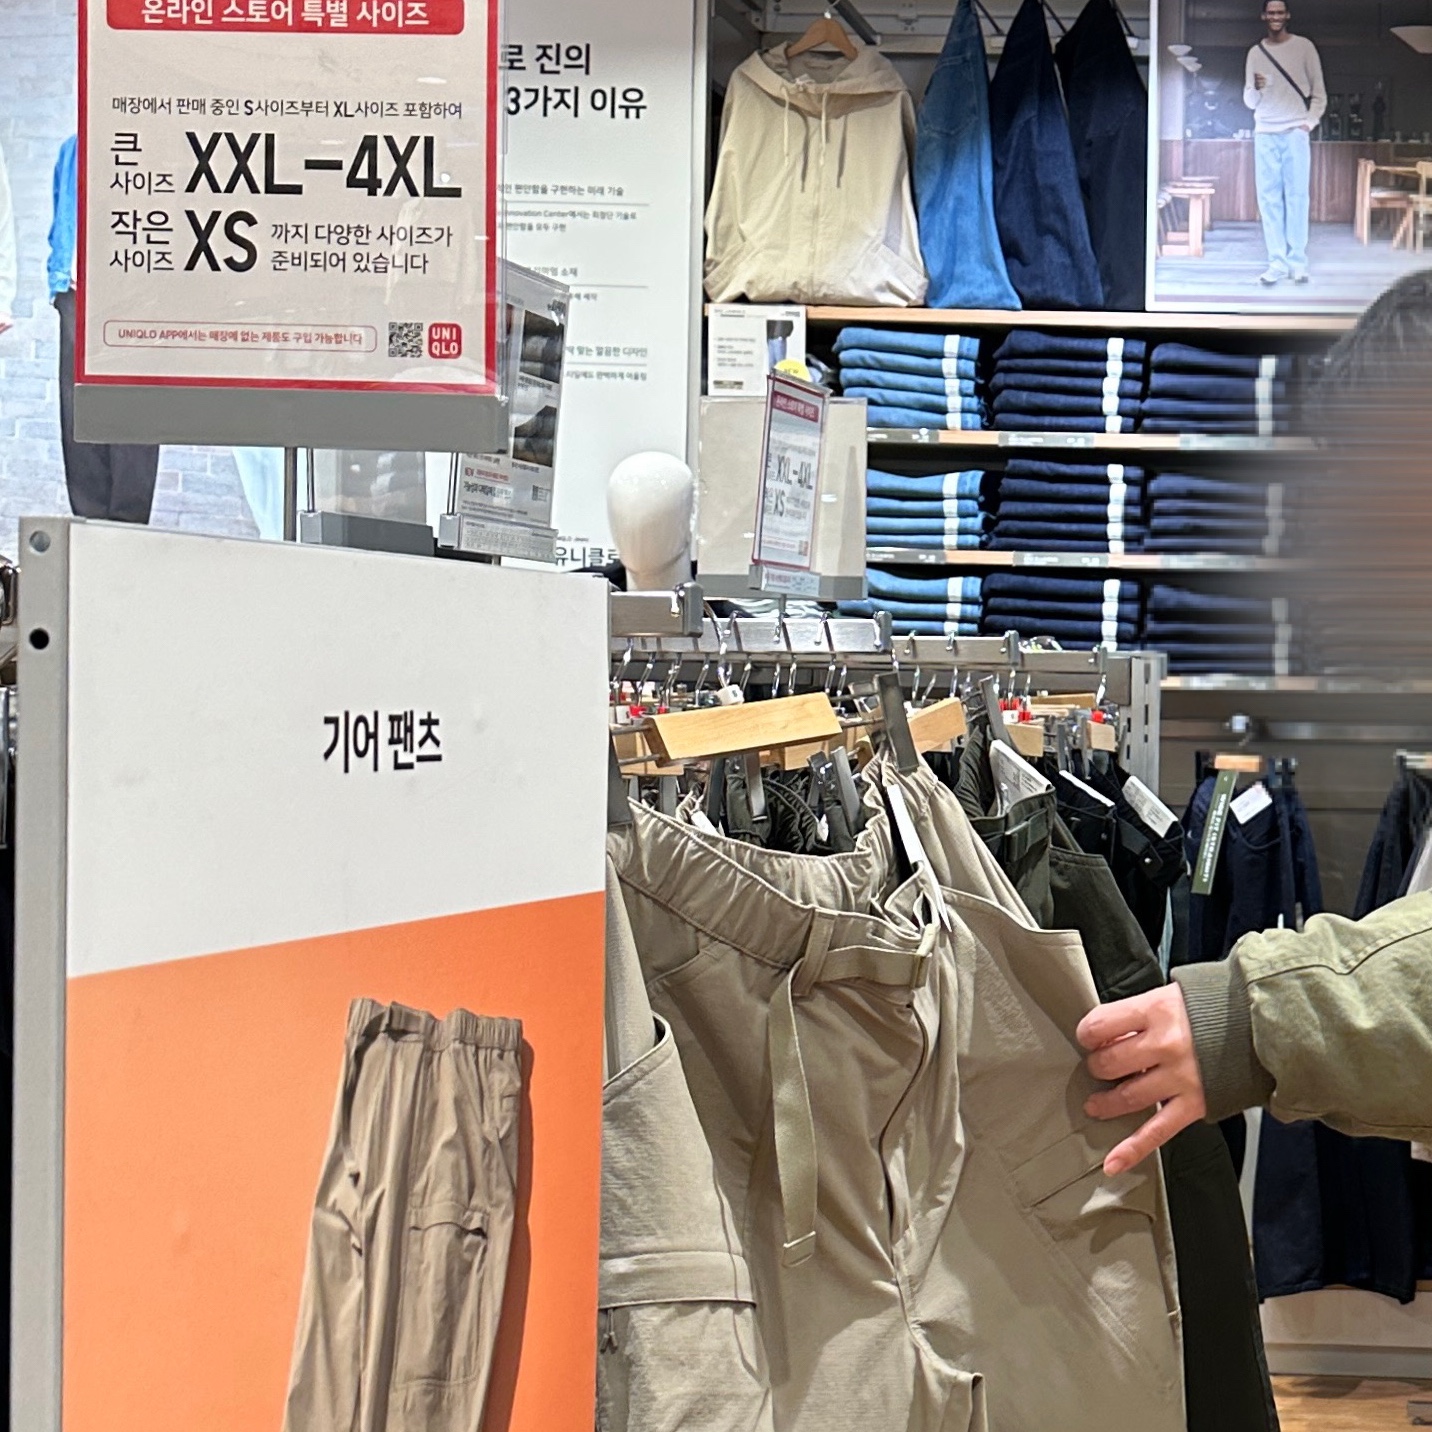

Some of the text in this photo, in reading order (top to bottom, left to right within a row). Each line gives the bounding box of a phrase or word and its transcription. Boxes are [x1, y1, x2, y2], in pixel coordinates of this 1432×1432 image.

[141, 0, 430, 28] 온라인 스토어 특별 사이즈
[535, 43, 590, 76] 진의
[112, 97, 463, 119] 매장에서 판매 중인 S사이즈부터 XL사이즈 포함하여
[590, 87, 647, 119] 이유
[110, 132, 142, 166] 큰
[110, 172, 176, 195] 사이즈
[110, 210, 173, 245] 작은
[271, 223, 454, 247] 까지 다양한 사이즈가
[184, 210, 258, 272] XS
[110, 249, 174, 273] 사이즈
[271, 251, 429, 275] 준비되어 있습니다
[118, 329, 157, 339] UNIQLO
[159, 329, 207, 341] APP에서는
[293, 332, 312, 344] 구입
[315, 333, 362, 345] 가능합니다
[432, 327, 456, 340] UNI
[431, 341, 459, 356] QLO
[323, 711, 442, 773] 기어 팬츠
